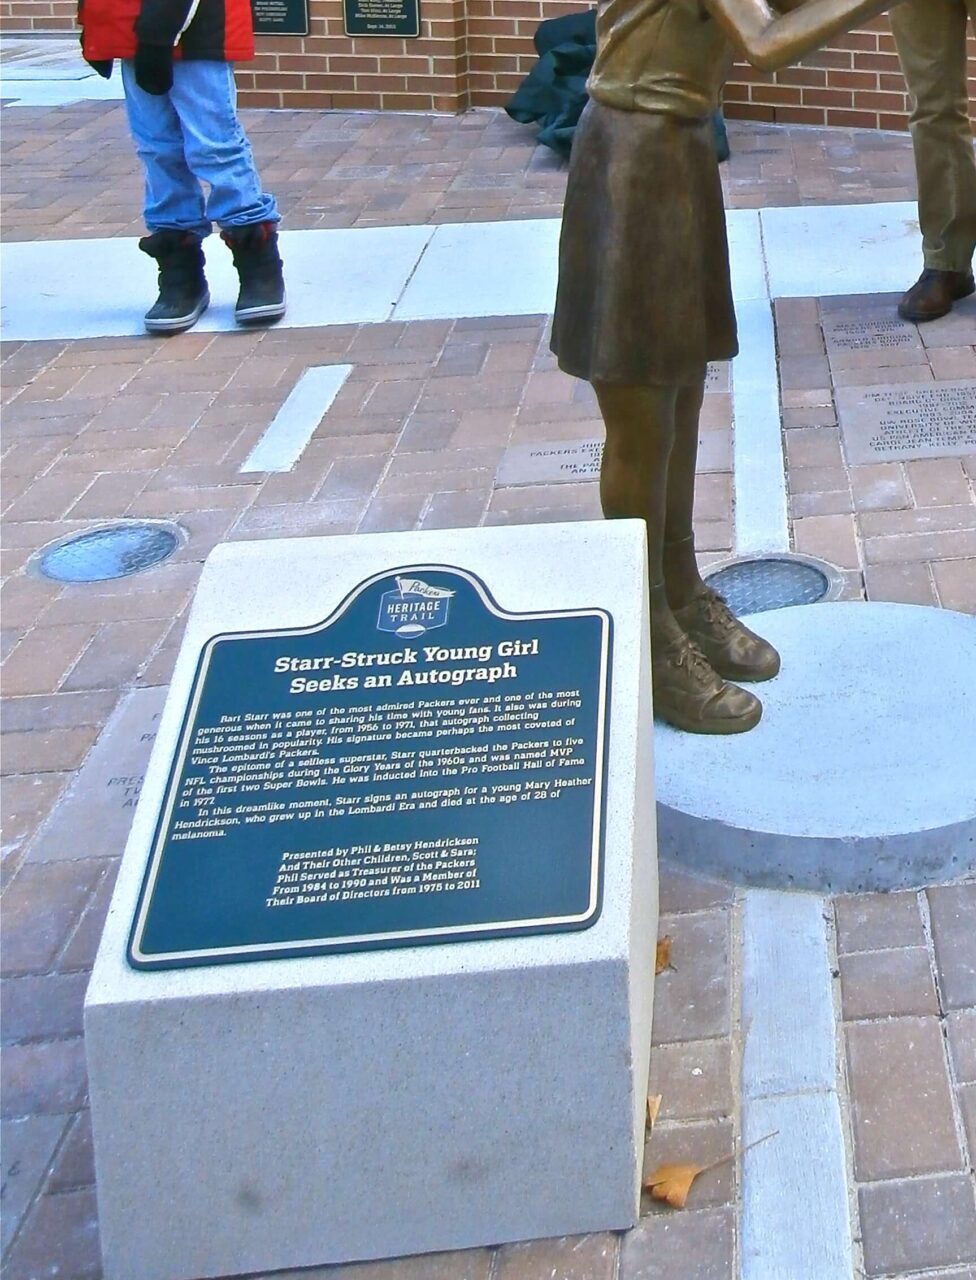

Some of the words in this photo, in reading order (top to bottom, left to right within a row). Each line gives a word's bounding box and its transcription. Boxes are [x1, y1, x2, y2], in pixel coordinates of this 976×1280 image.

[387, 600, 441, 614] HERITAGE
[390, 611, 435, 622] TRAIL
[275, 649, 416, 672] Starr-Struck
[424, 647, 491, 661] Young
[498, 640, 538, 656] Girl
[290, 675, 358, 693] Seeks
[364, 675, 391, 688] an
[398, 663, 516, 685] Autograph
[220, 715, 241, 723] Bart
[349, 706, 372, 714] most
[376, 702, 414, 712] admired
[418, 700, 455, 708] Packers
[458, 698, 480, 706] ever
[483, 695, 501, 703] and
[504, 695, 521, 703] one
[555, 690, 579, 699] most
[232, 763, 271, 772] epitome
[275, 760, 285, 768] of
[298, 758, 335, 766] selfless
[419, 745, 488, 758] quarterbacked
[512, 741, 549, 750] Packers
[552, 740, 562, 750] to
[565, 738, 583, 748] five
[279, 862, 300, 872] And
[303, 860, 330, 869] Their
[332, 858, 361, 867] Other
[412, 851, 438, 860] Scott
[440, 850, 449, 858] &
[283, 849, 333, 860] Presented
[336, 848, 348, 857] by
[351, 846, 371, 854] Phil
[383, 844, 412, 852] Betsy
[414, 838, 478, 849] Hendrickson
[273, 886, 299, 895] From
[342, 879, 366, 888] 1990
[368, 877, 388, 886] and
[391, 876, 411, 884] Was
[422, 872, 464, 881] Member
[466, 869, 476, 877] of
[277, 874, 298, 883] Phil
[300, 871, 336, 881] Served
[338, 870, 350, 878] as
[352, 866, 401, 876] Treasurer
[404, 864, 414, 872] of
[416, 863, 433, 871] the
[435, 860, 475, 869] Packers
[266, 897, 294, 906] Their
[297, 894, 327, 904] Board
[329, 892, 340, 901] of
[342, 889, 390, 899] Directors
[392, 887, 416, 895] from
[457, 880, 480, 889] 2011
